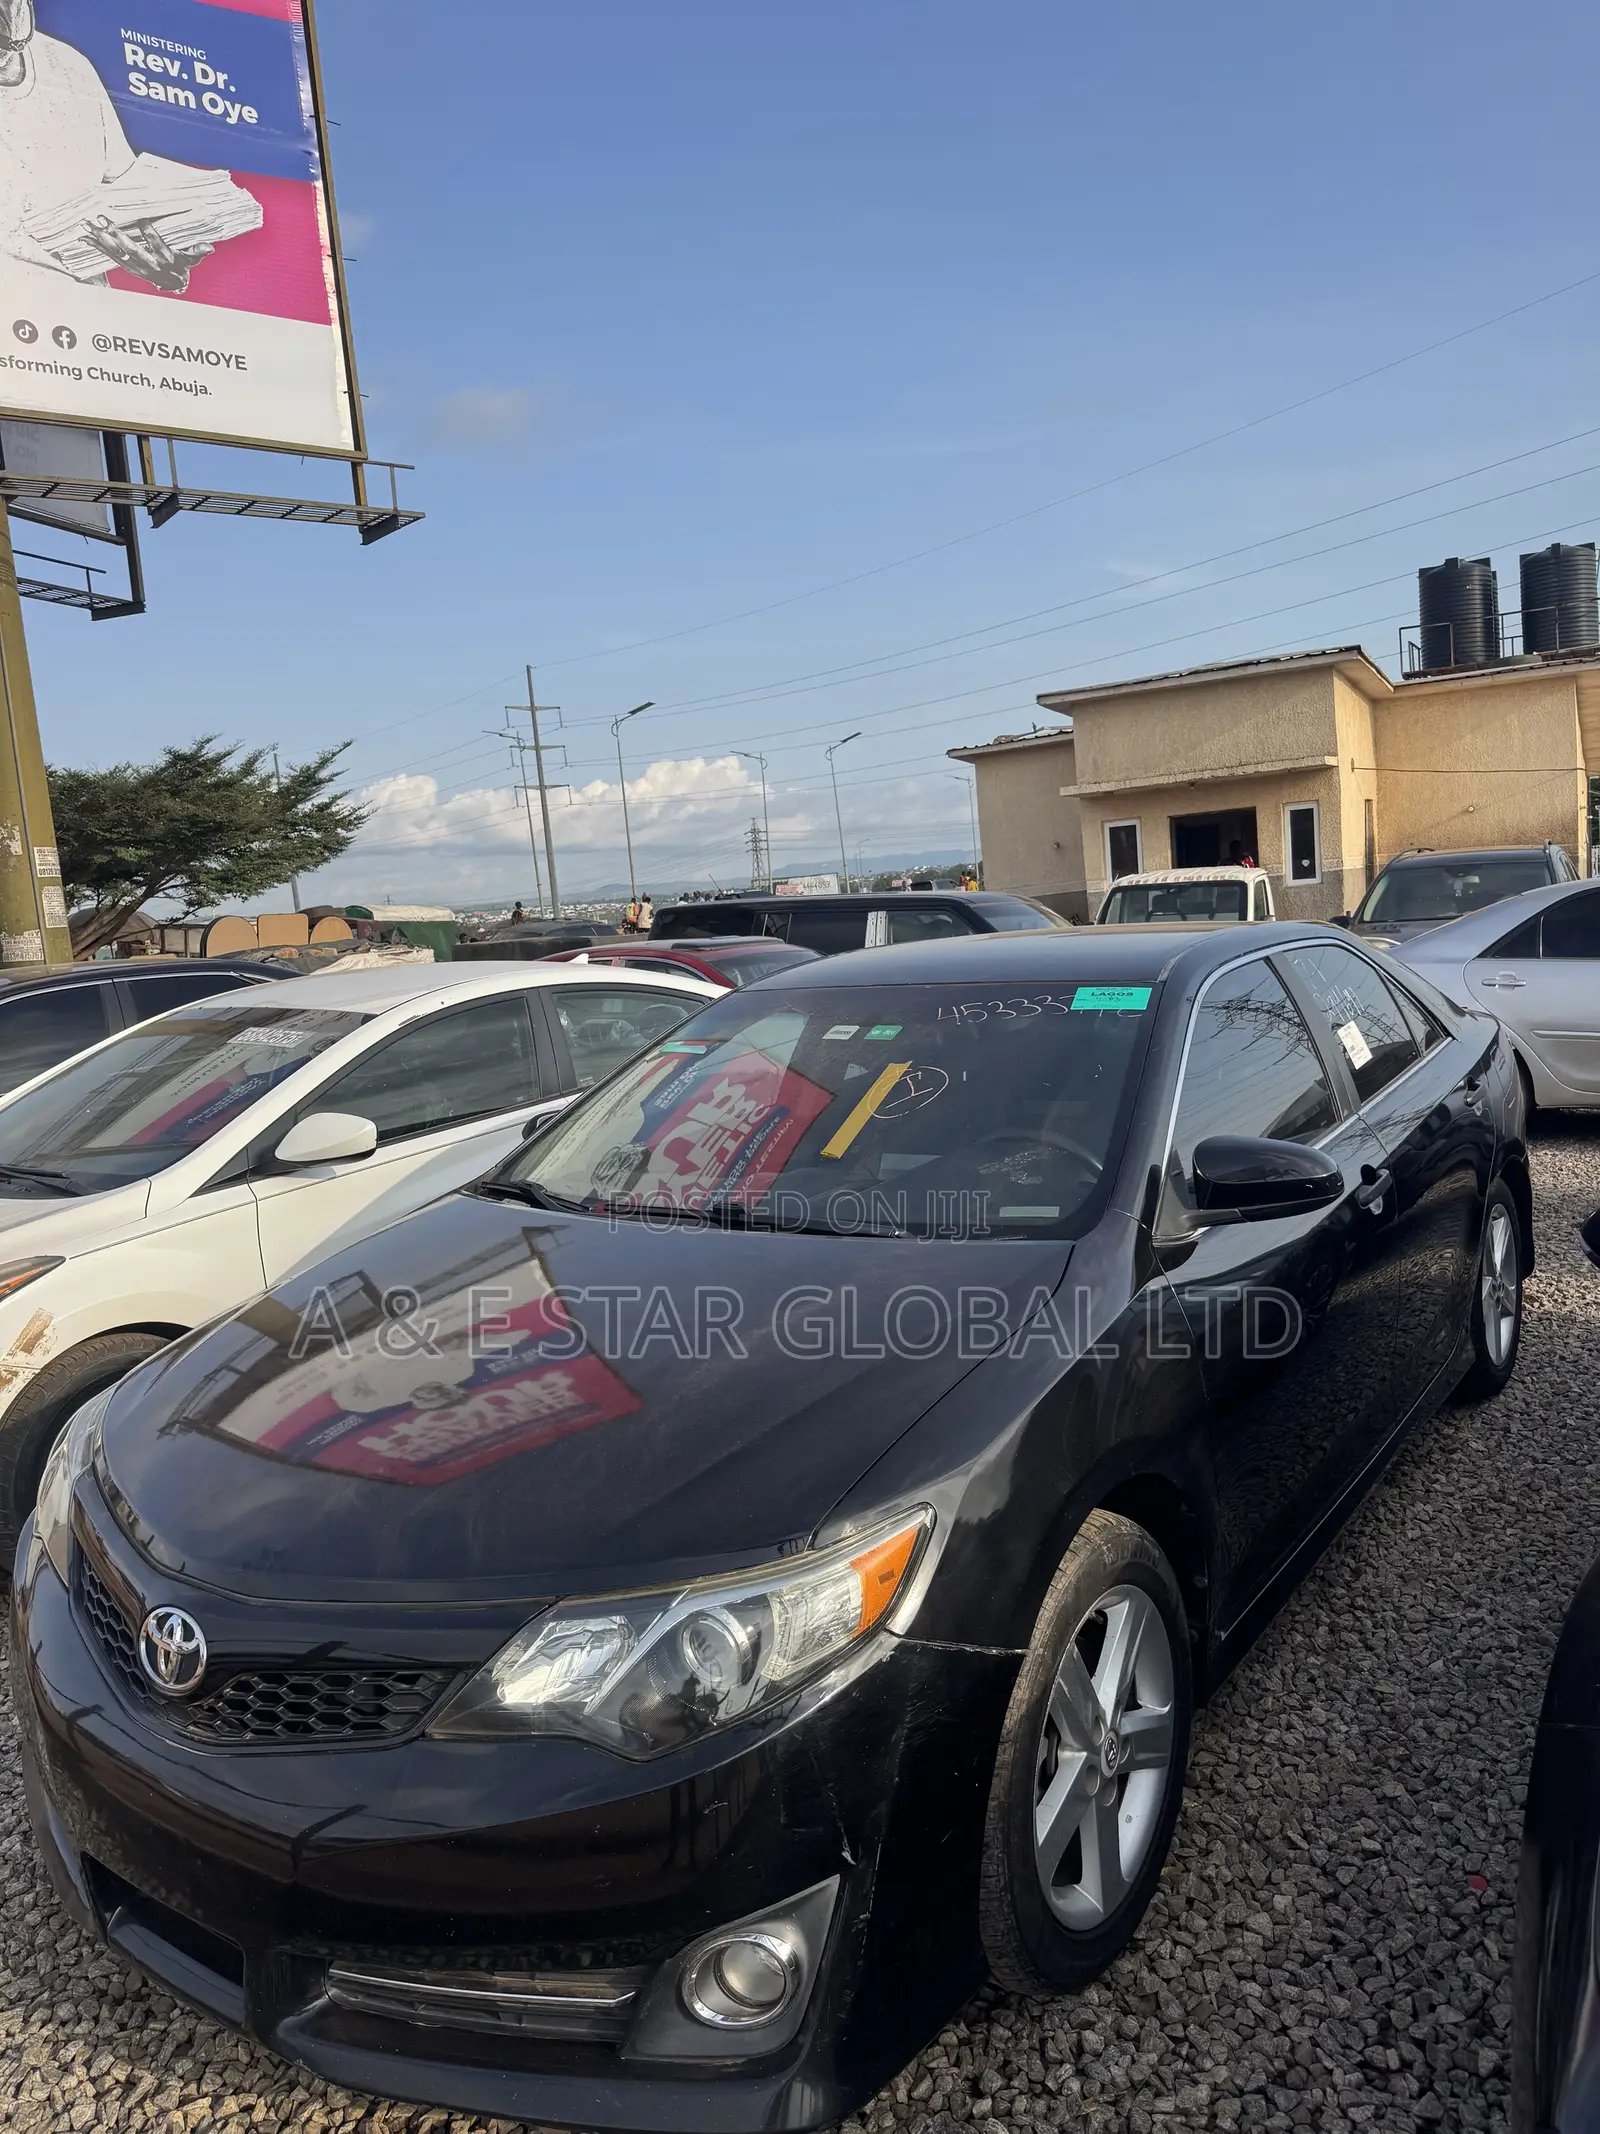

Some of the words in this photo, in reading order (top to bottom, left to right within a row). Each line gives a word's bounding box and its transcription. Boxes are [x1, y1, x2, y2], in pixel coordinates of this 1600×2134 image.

[120, 28, 206, 60] MINISTERING
[124, 42, 189, 80] Rev.
[193, 61, 236, 93] Dr.
[128, 72, 197, 110] Sam
[201, 91, 259, 125] Oye
[92, 333, 248, 371] @REVSAMOYE
[87, 366, 155, 389] Church,
[159, 376, 213, 397] Abuja.
